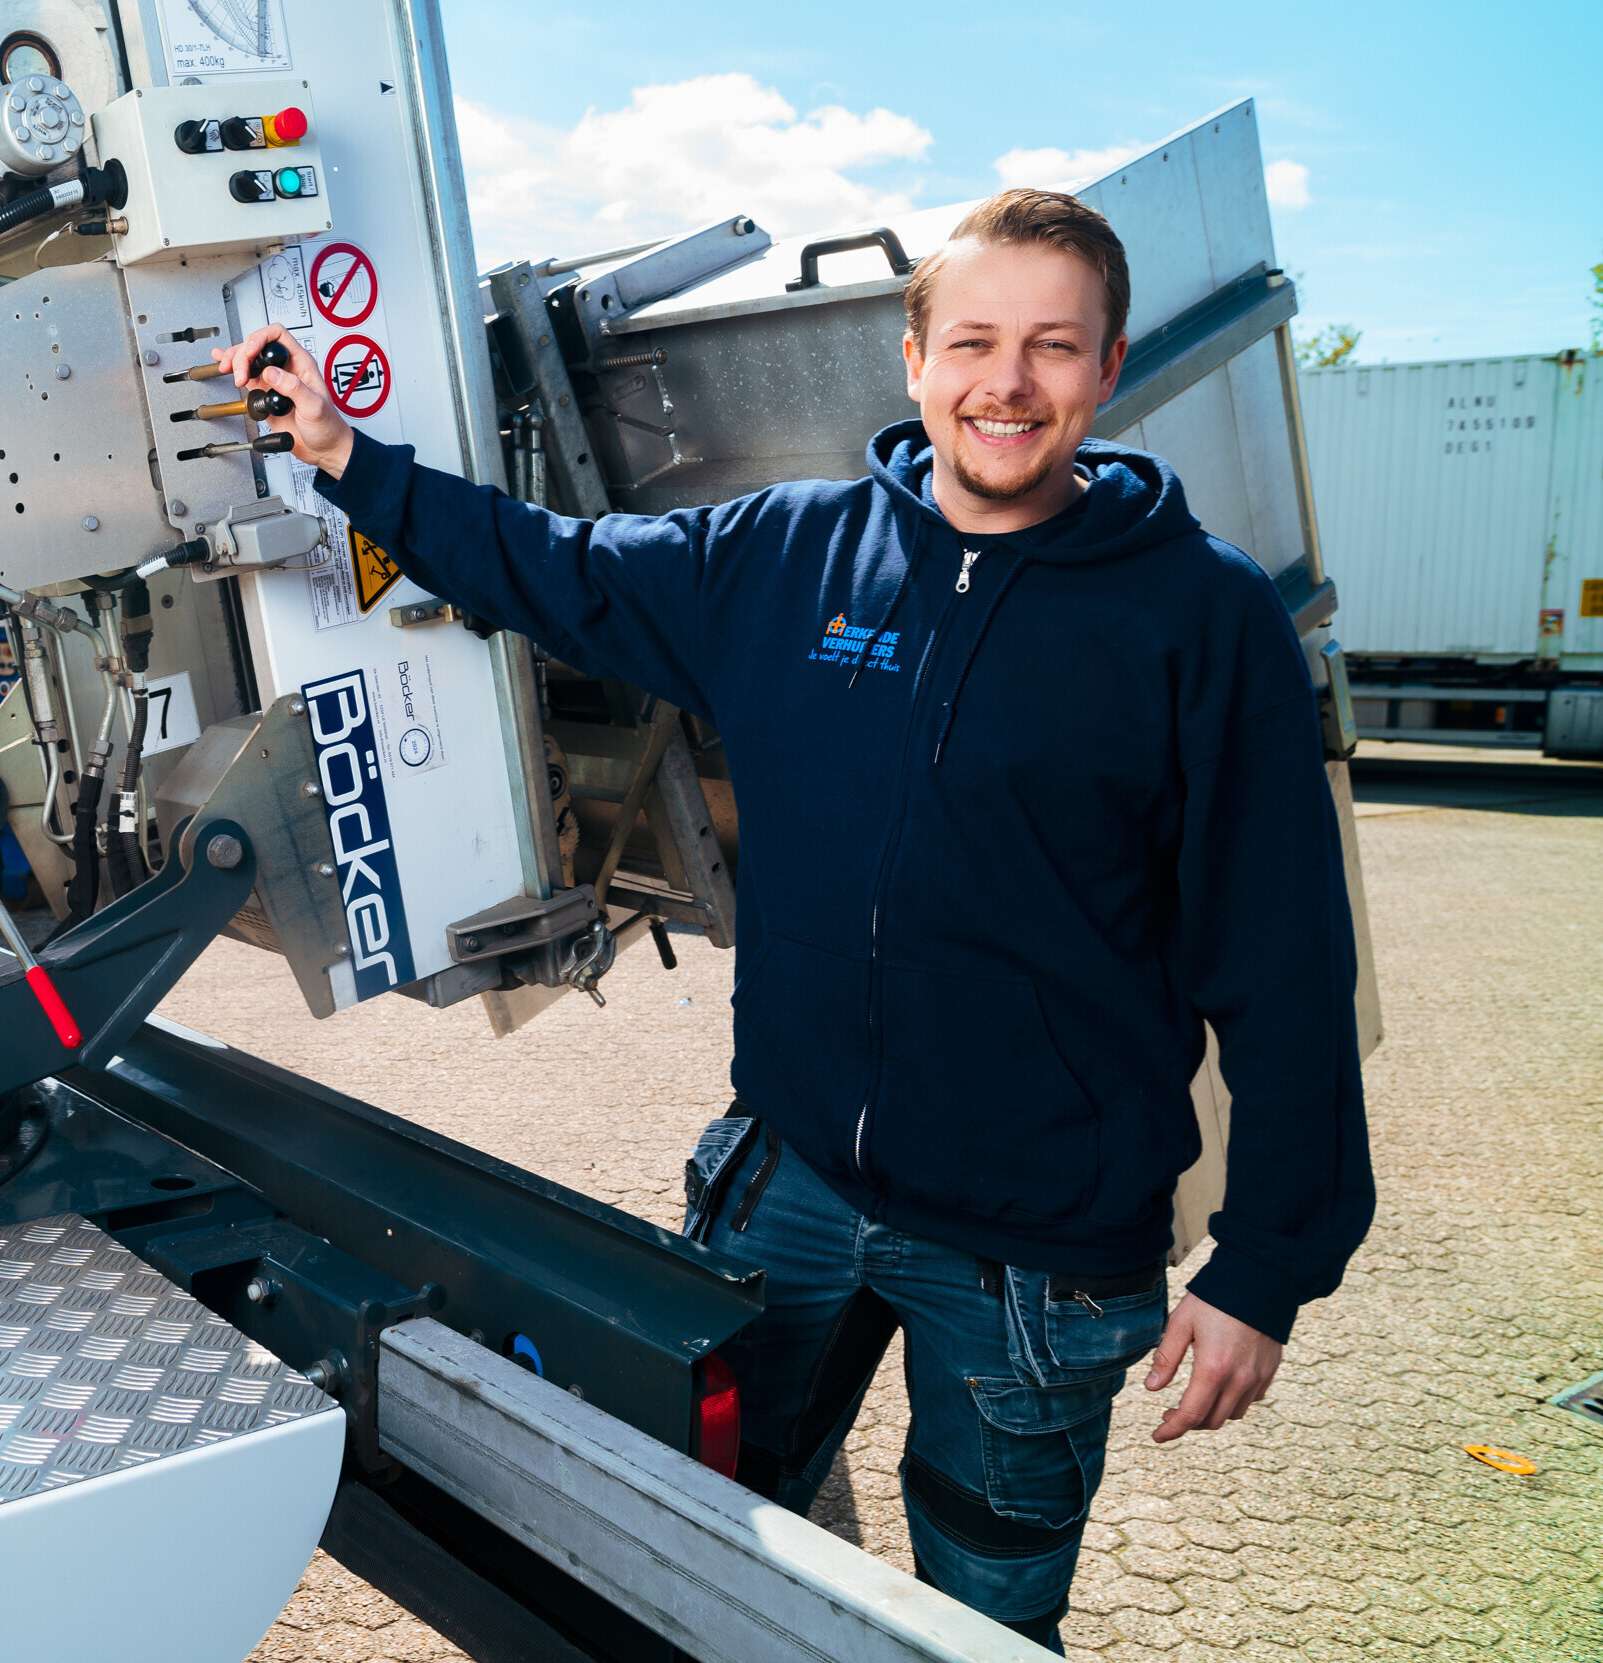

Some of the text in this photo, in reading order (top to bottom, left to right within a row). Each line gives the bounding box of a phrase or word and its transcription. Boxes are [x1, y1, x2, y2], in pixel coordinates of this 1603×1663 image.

[200, 55, 225, 69] 400kg
[296, 283, 307, 318] 45km/h
[822, 636, 895, 658] VERHUIERS
[148, 686, 173, 740] 7
[398, 661, 416, 721] Böcker
[305, 673, 399, 986] Böcker
